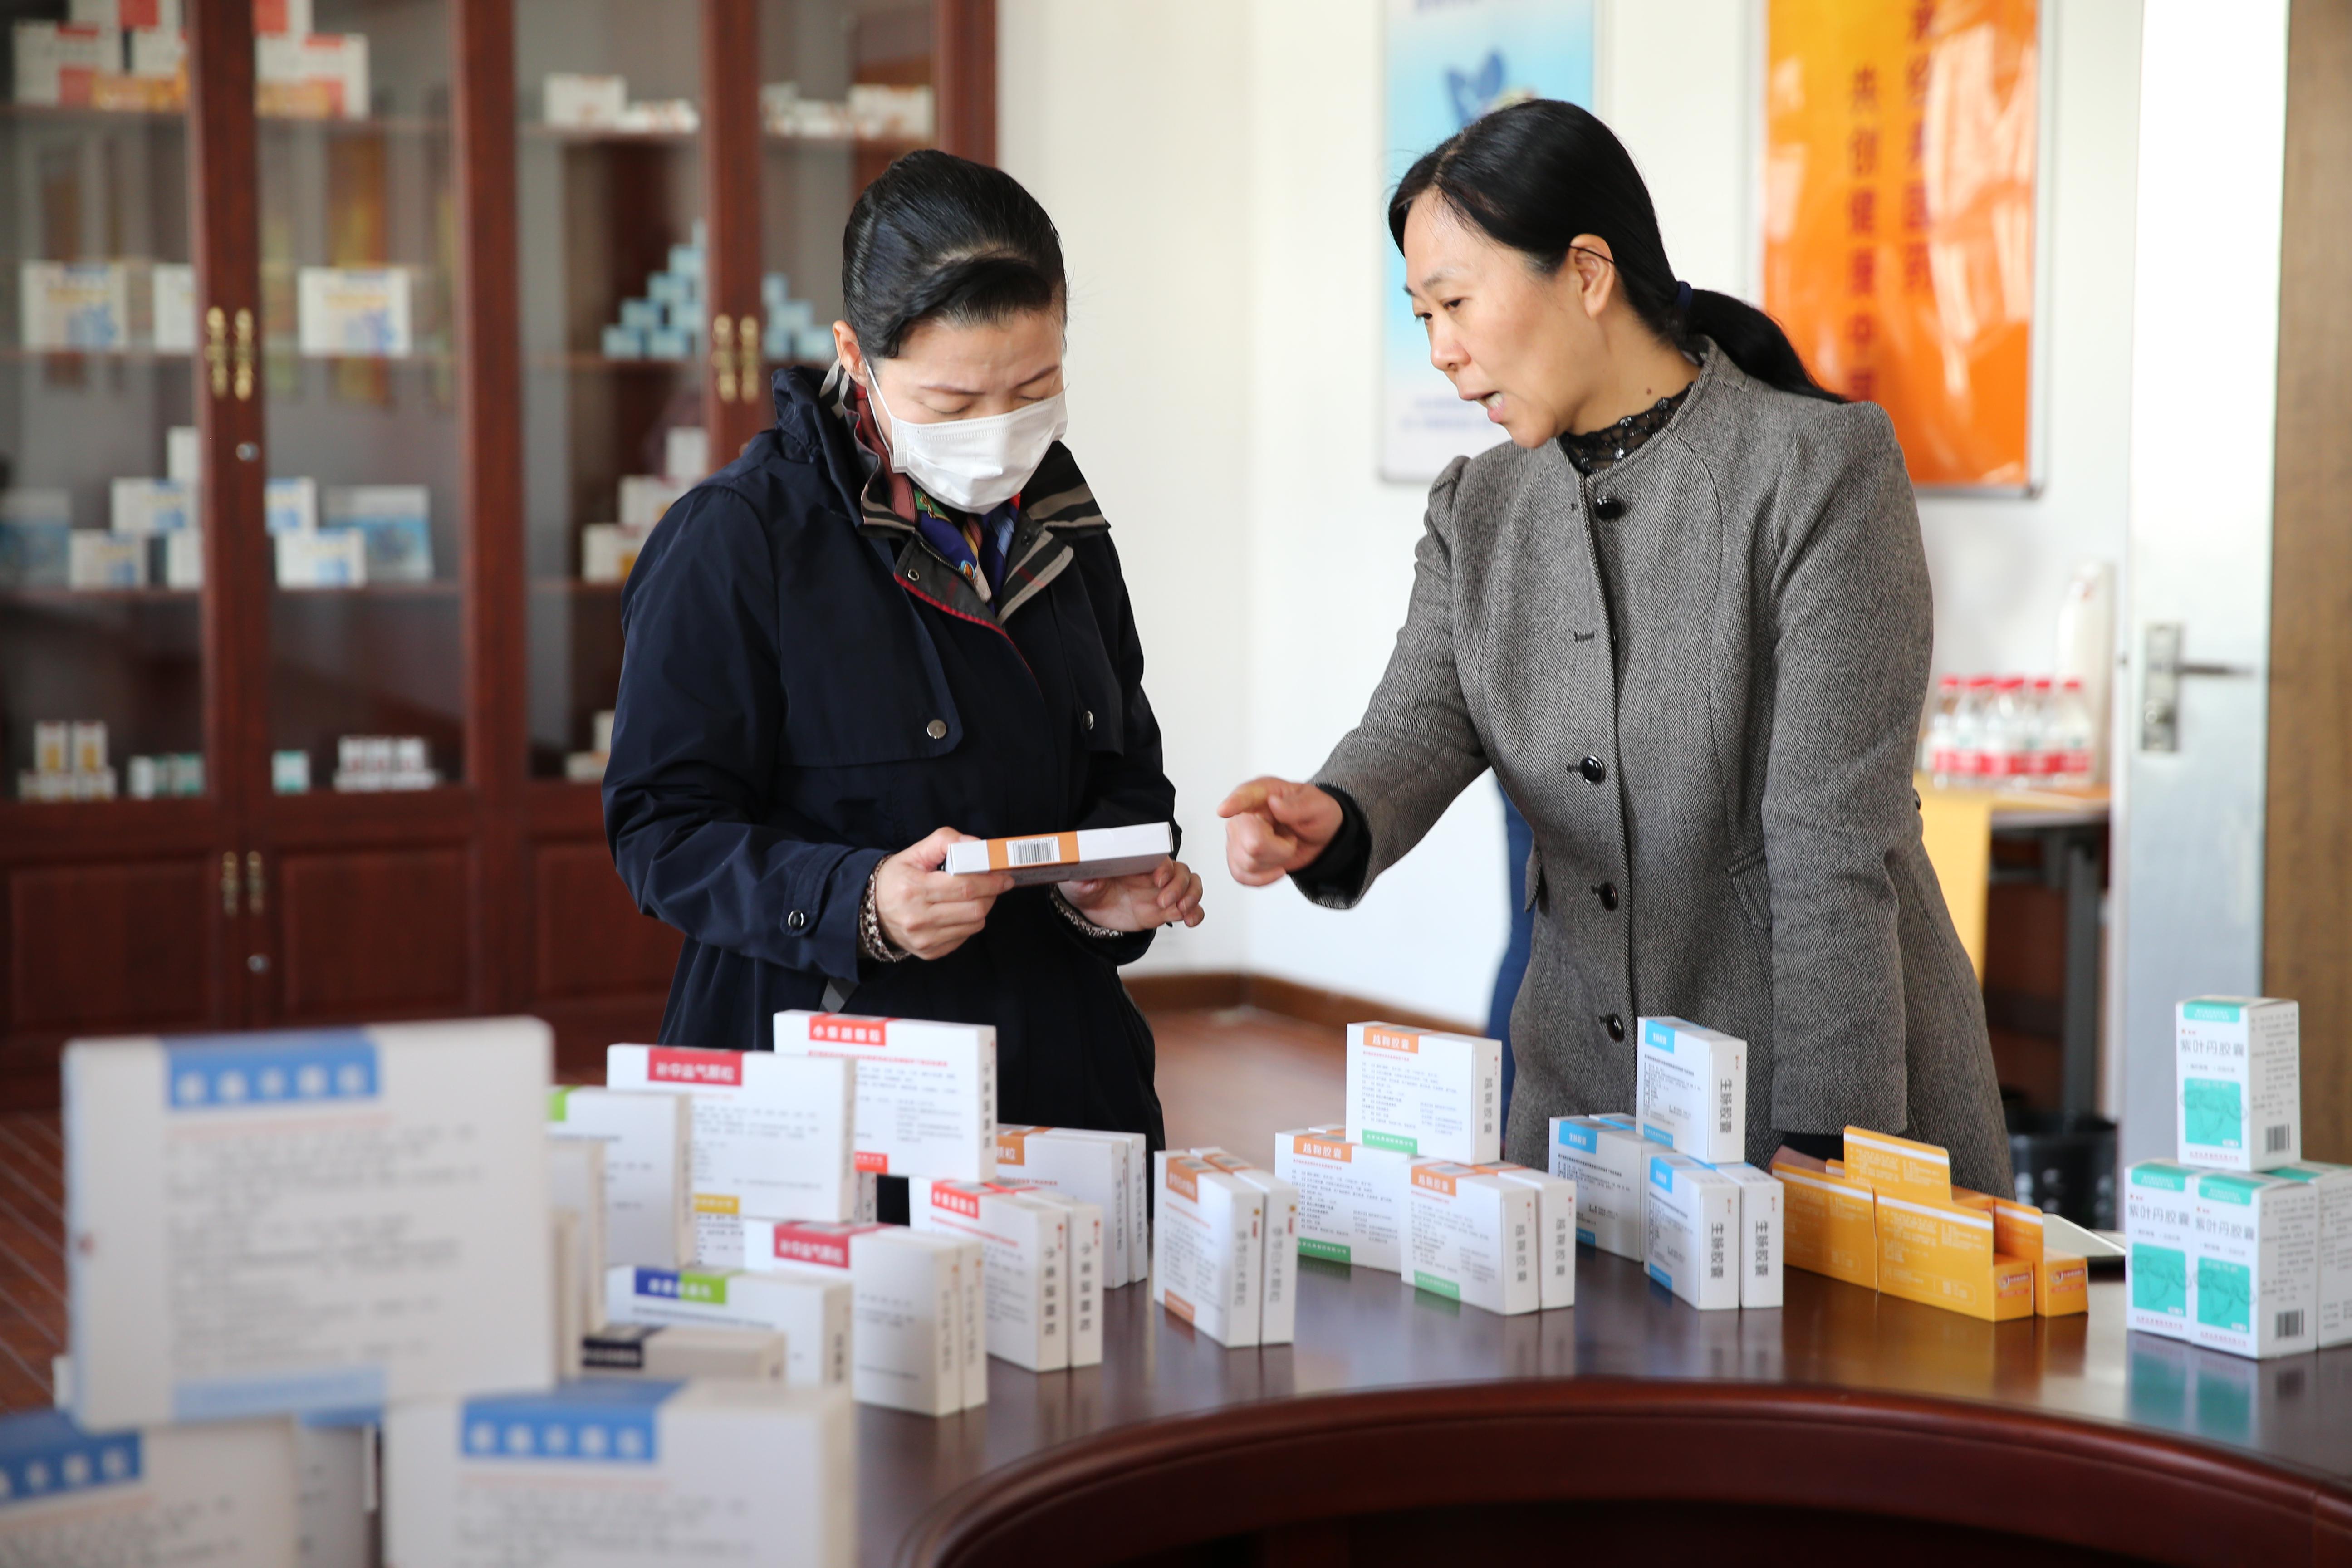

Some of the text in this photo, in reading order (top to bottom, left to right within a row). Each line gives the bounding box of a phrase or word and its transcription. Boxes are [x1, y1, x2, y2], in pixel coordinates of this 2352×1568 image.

[812, 1024, 881, 1042] 小柴胡颗粒
[1372, 1034, 1410, 1050] 越鞠胶囊
[2180, 1038, 2244, 1057] 紫叶丹胶囊
[1720, 1078, 1733, 1134] 生脉胶囊
[1303, 1142, 1342, 1159] 越鞠胶囊
[2128, 1203, 2189, 1226] 紫叶丹胶囊
[2195, 1216, 2255, 1240] 紫叶丹胶囊
[1710, 1222, 1724, 1280] 生脉胶囊
[1755, 1220, 1769, 1278] 生脉胶囊
